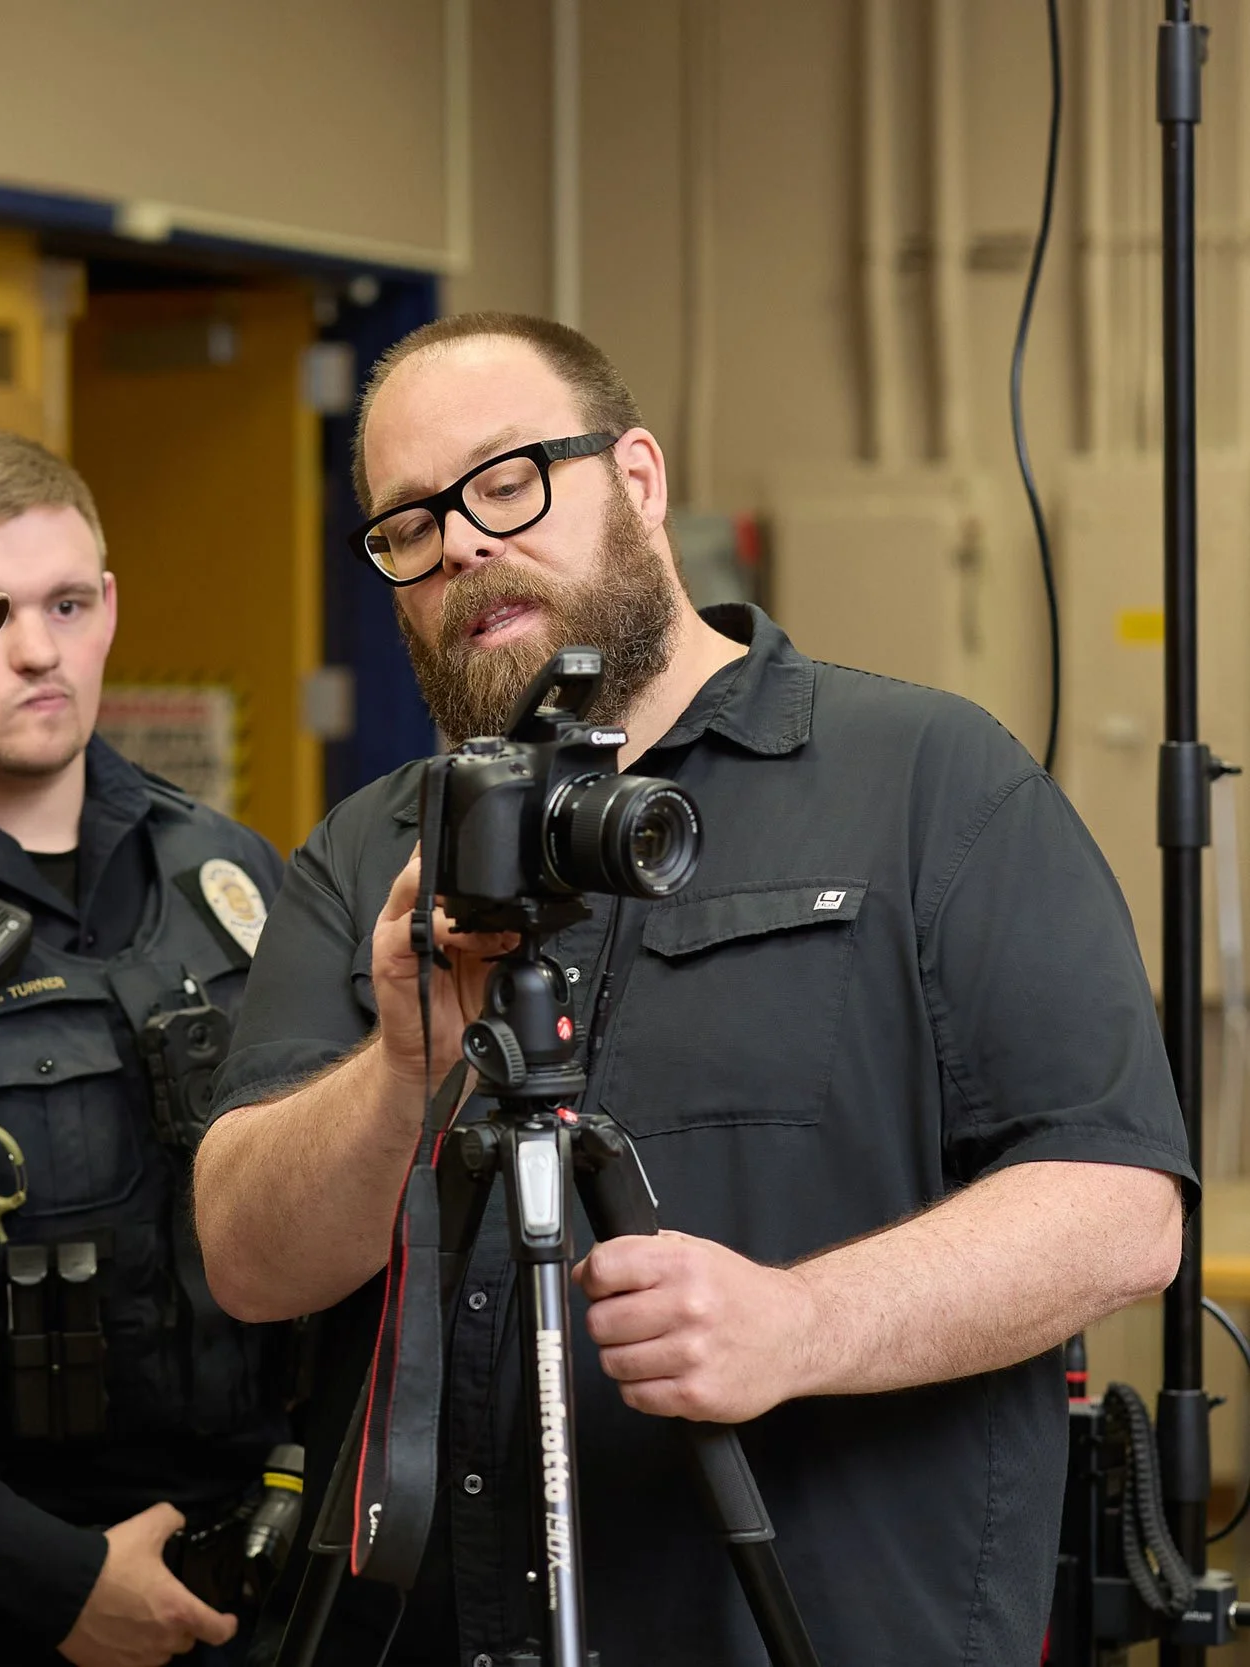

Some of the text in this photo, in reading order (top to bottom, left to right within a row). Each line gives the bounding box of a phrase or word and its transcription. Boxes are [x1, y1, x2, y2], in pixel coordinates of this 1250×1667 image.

[591, 731, 626, 745] Canon
[6, 976, 67, 999] TURNER
[536, 1329, 571, 1575] Manfrotto 190X
